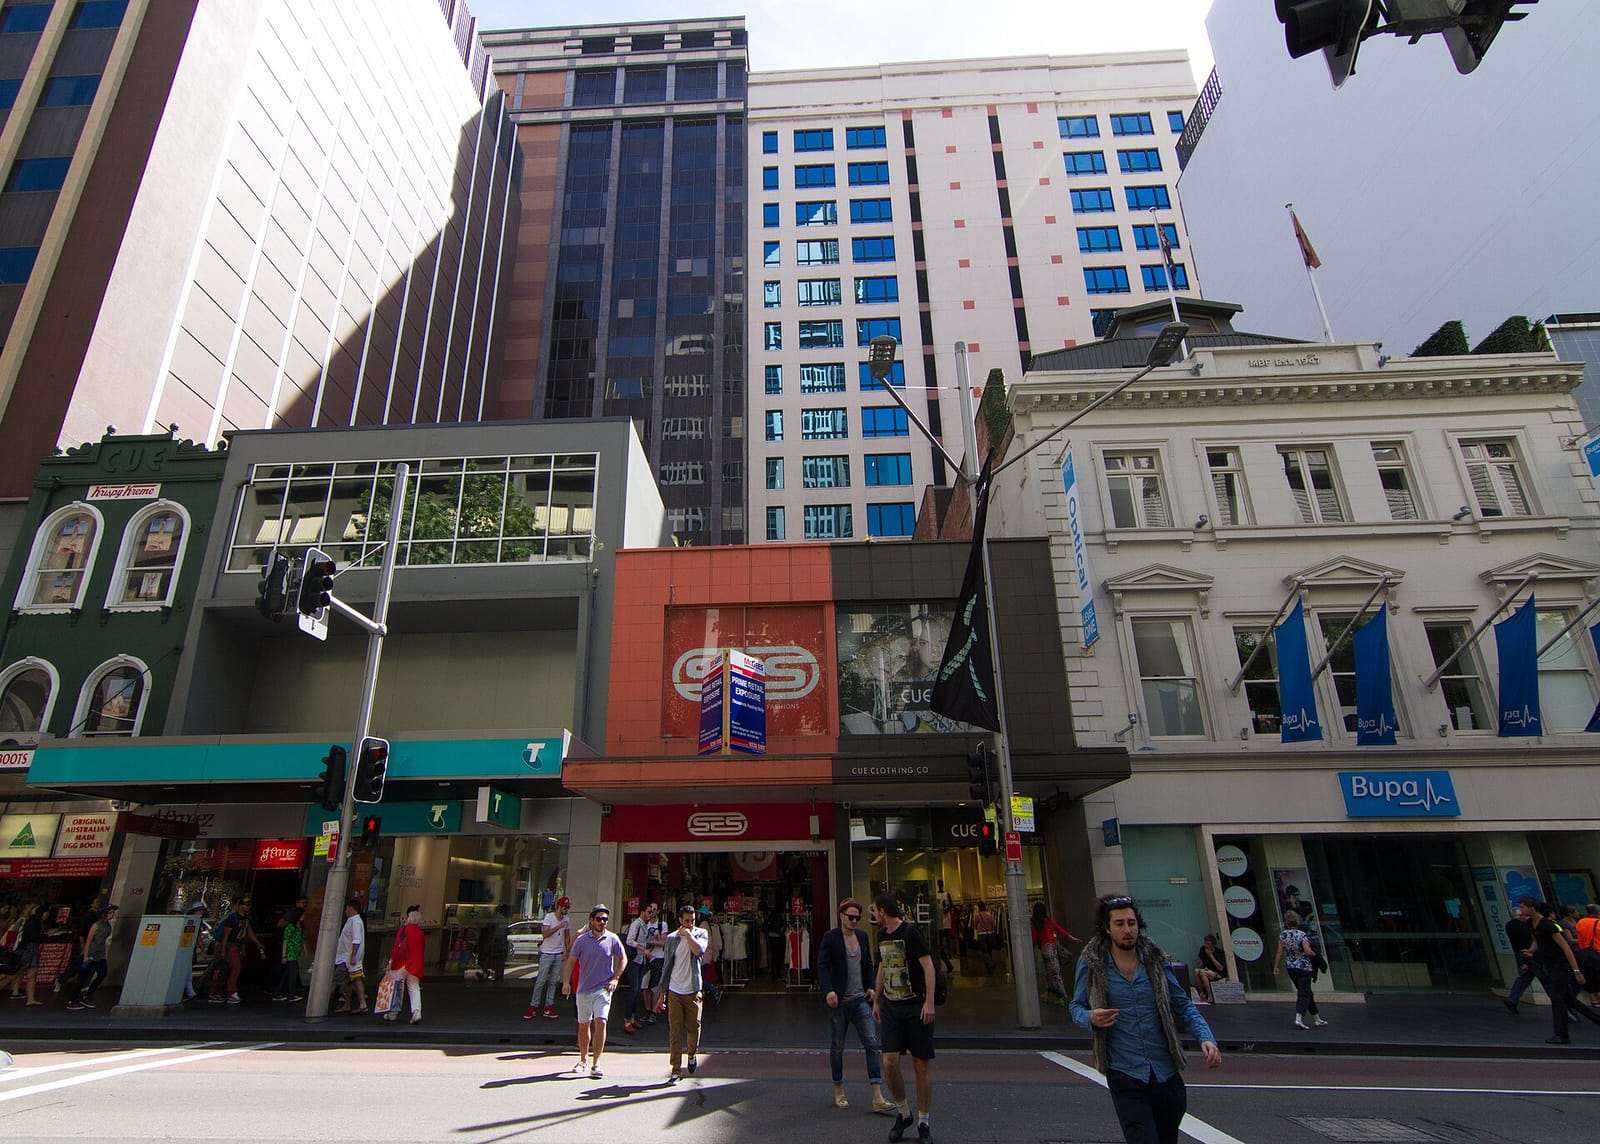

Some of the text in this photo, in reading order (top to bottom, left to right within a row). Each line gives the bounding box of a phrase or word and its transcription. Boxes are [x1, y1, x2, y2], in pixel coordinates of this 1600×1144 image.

[1248, 359, 1270, 368] MBF
[1296, 356, 1320, 367] 1947
[103, 447, 166, 474] CUE
[91, 484, 156, 498] Krispy Kreme
[1069, 496, 1088, 591] Optical
[735, 687, 761, 702] EXPOSURE
[851, 766, 929, 775] CUE CLOTHING CO
[1351, 775, 1419, 802] Bupa
[688, 812, 749, 836] SES
[951, 824, 978, 838] CUE
[1490, 904, 1510, 950] Optical
